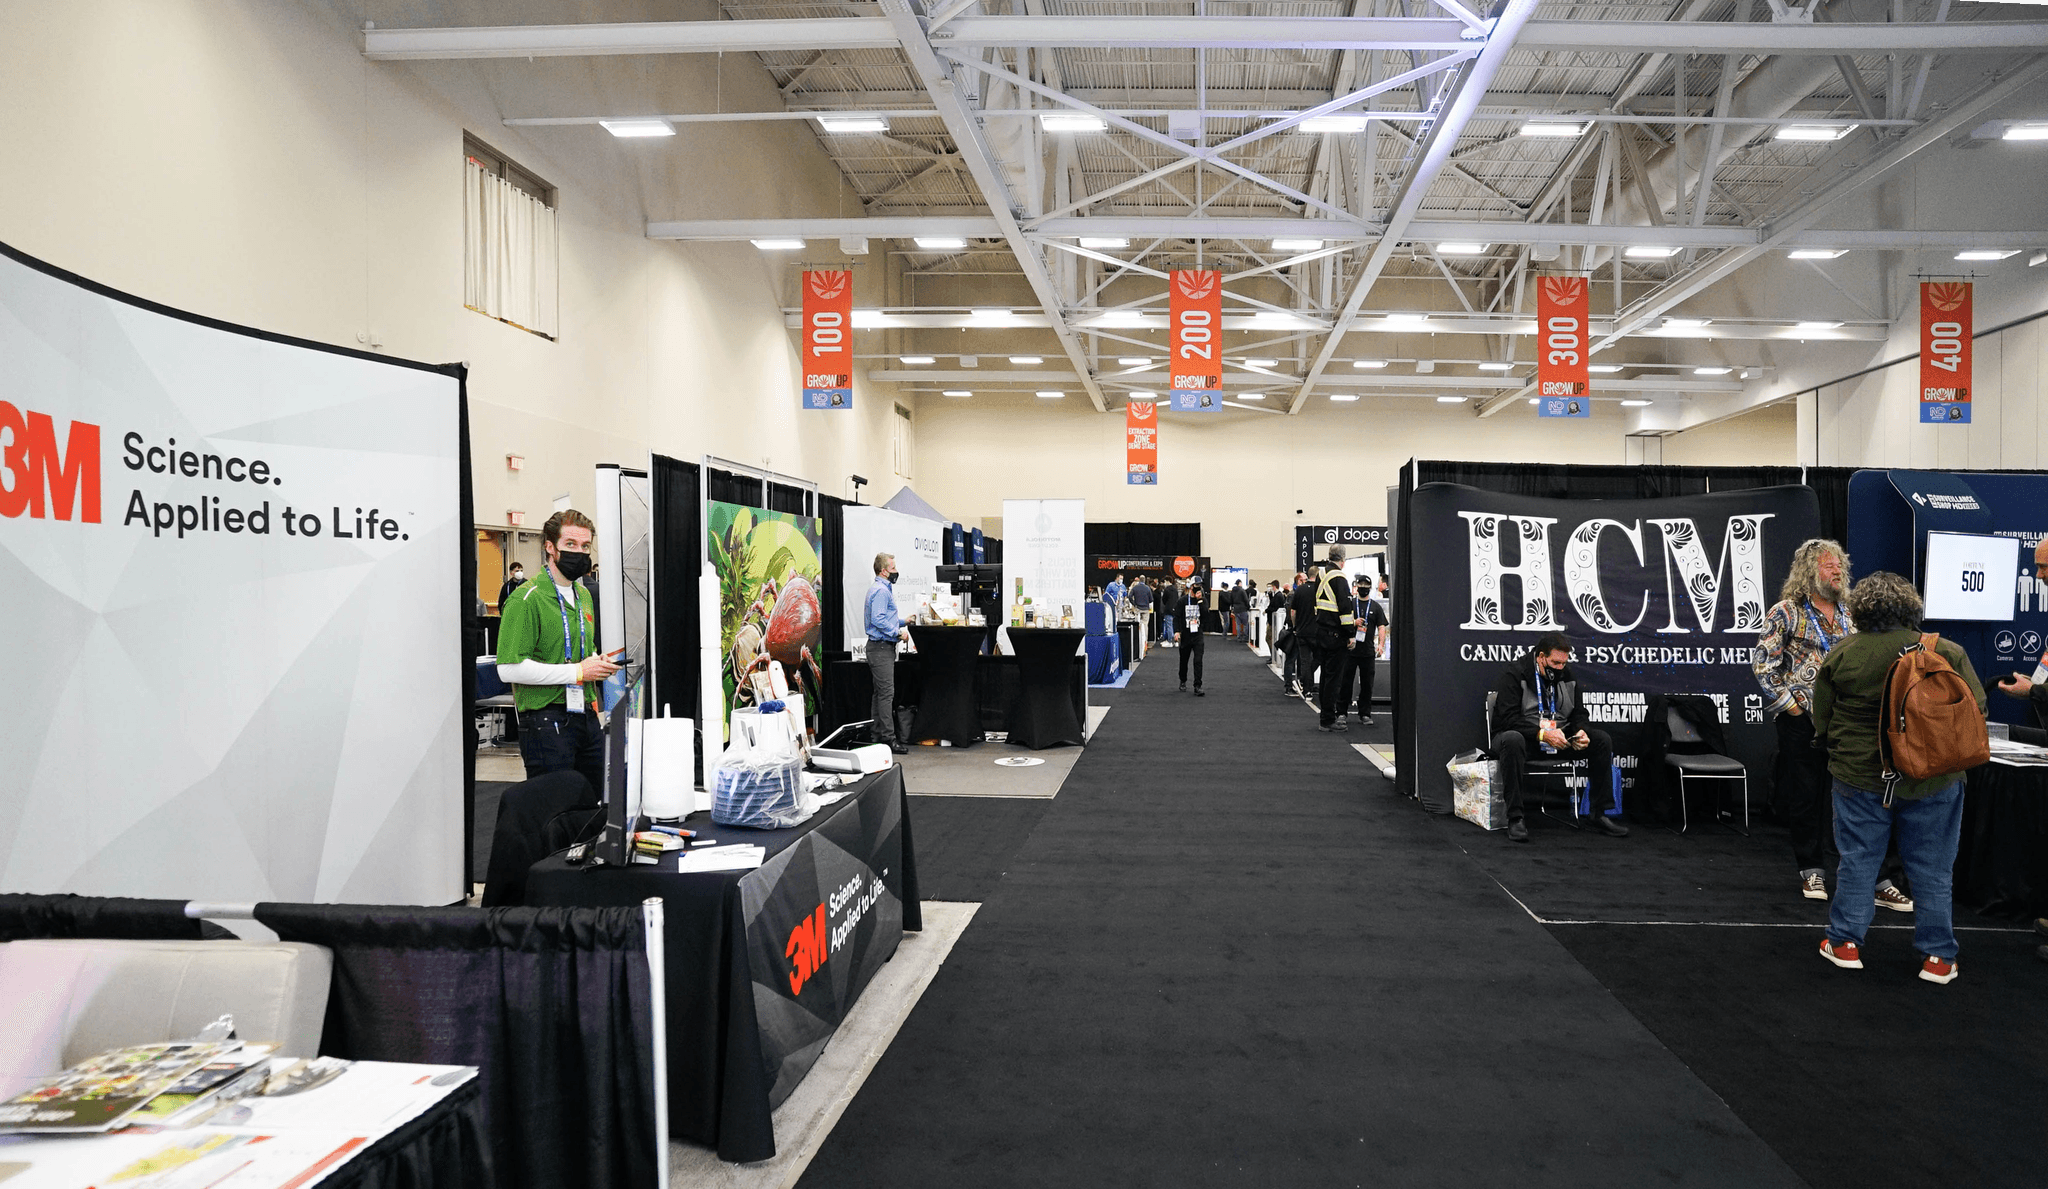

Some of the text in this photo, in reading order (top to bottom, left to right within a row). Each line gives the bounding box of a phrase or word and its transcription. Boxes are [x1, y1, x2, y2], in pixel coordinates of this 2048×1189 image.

[812, 311, 843, 357] 100
[1180, 310, 1212, 359] 200
[1547, 316, 1579, 366] 300
[1930, 321, 1962, 373] 400
[0, 400, 101, 524] 3M
[123, 431, 282, 486] Science.
[1133, 434, 1150, 444] ZONE
[123, 489, 270, 539] Applied
[281, 506, 322, 537] to
[1343, 528, 1380, 543] dope
[1457, 510, 1776, 634] HCM
[1961, 570, 1985, 593] 500
[1460, 643, 1535, 663] CANNA
[1585, 643, 1715, 665] PSYCHEDELIC
[1582, 692, 1646, 705] HIGH! CANADA
[1745, 709, 1763, 722] CPN
[829, 873, 863, 918] Science.
[785, 901, 828, 996] 3M
[830, 897, 861, 954] Applied
[861, 894, 870, 915] to
